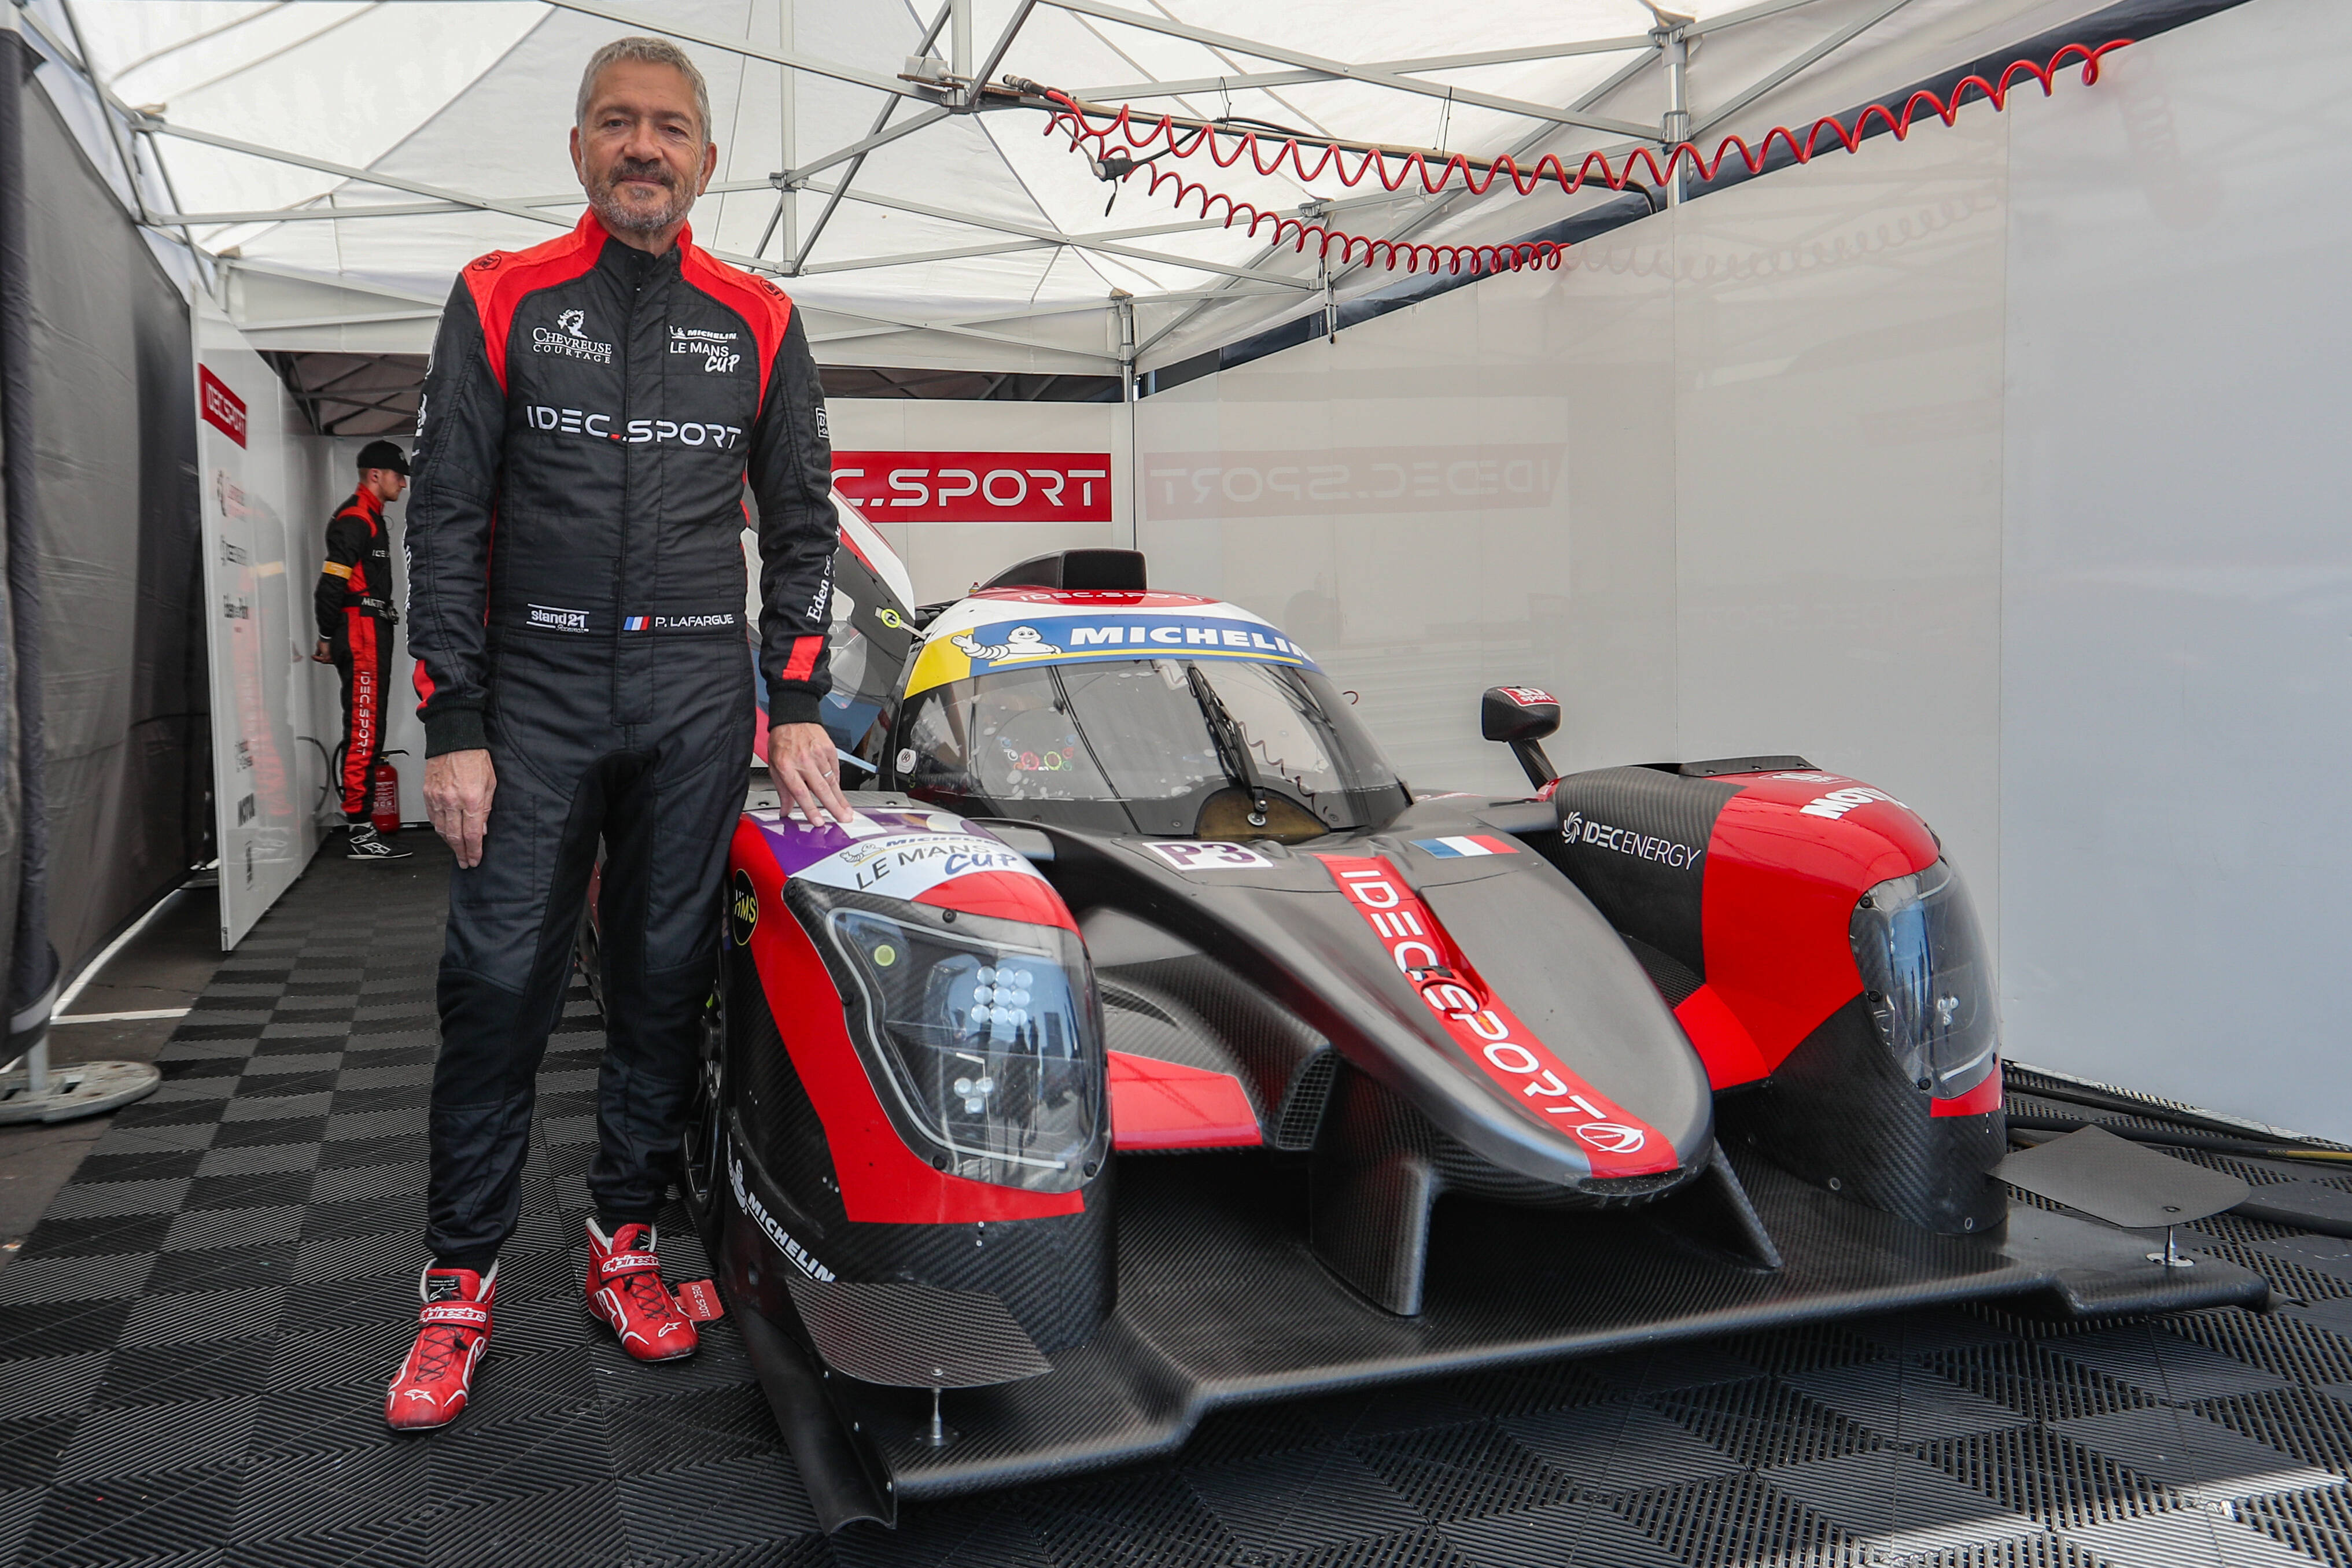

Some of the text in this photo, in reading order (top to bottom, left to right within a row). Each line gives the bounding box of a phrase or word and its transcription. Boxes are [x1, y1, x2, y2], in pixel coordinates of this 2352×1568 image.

[533, 327, 612, 355] CHEVREUSE
[687, 330, 737, 340] MICHELIN
[533, 344, 610, 364] COURTAGE
[670, 341, 729, 357] LE MANS
[705, 354, 740, 372] CUP
[806, 580, 830, 623] Eden
[655, 614, 735, 628] P. LAFARGUE
[356, 671, 371, 756] IDEC.SPORT
[886, 836, 1000, 847] MICHELIN
[945, 853, 1018, 875] CUP
[1154, 844, 1256, 865] P3
[856, 844, 991, 891] LE MANS
[748, 1191, 836, 1282] MICHELIN
